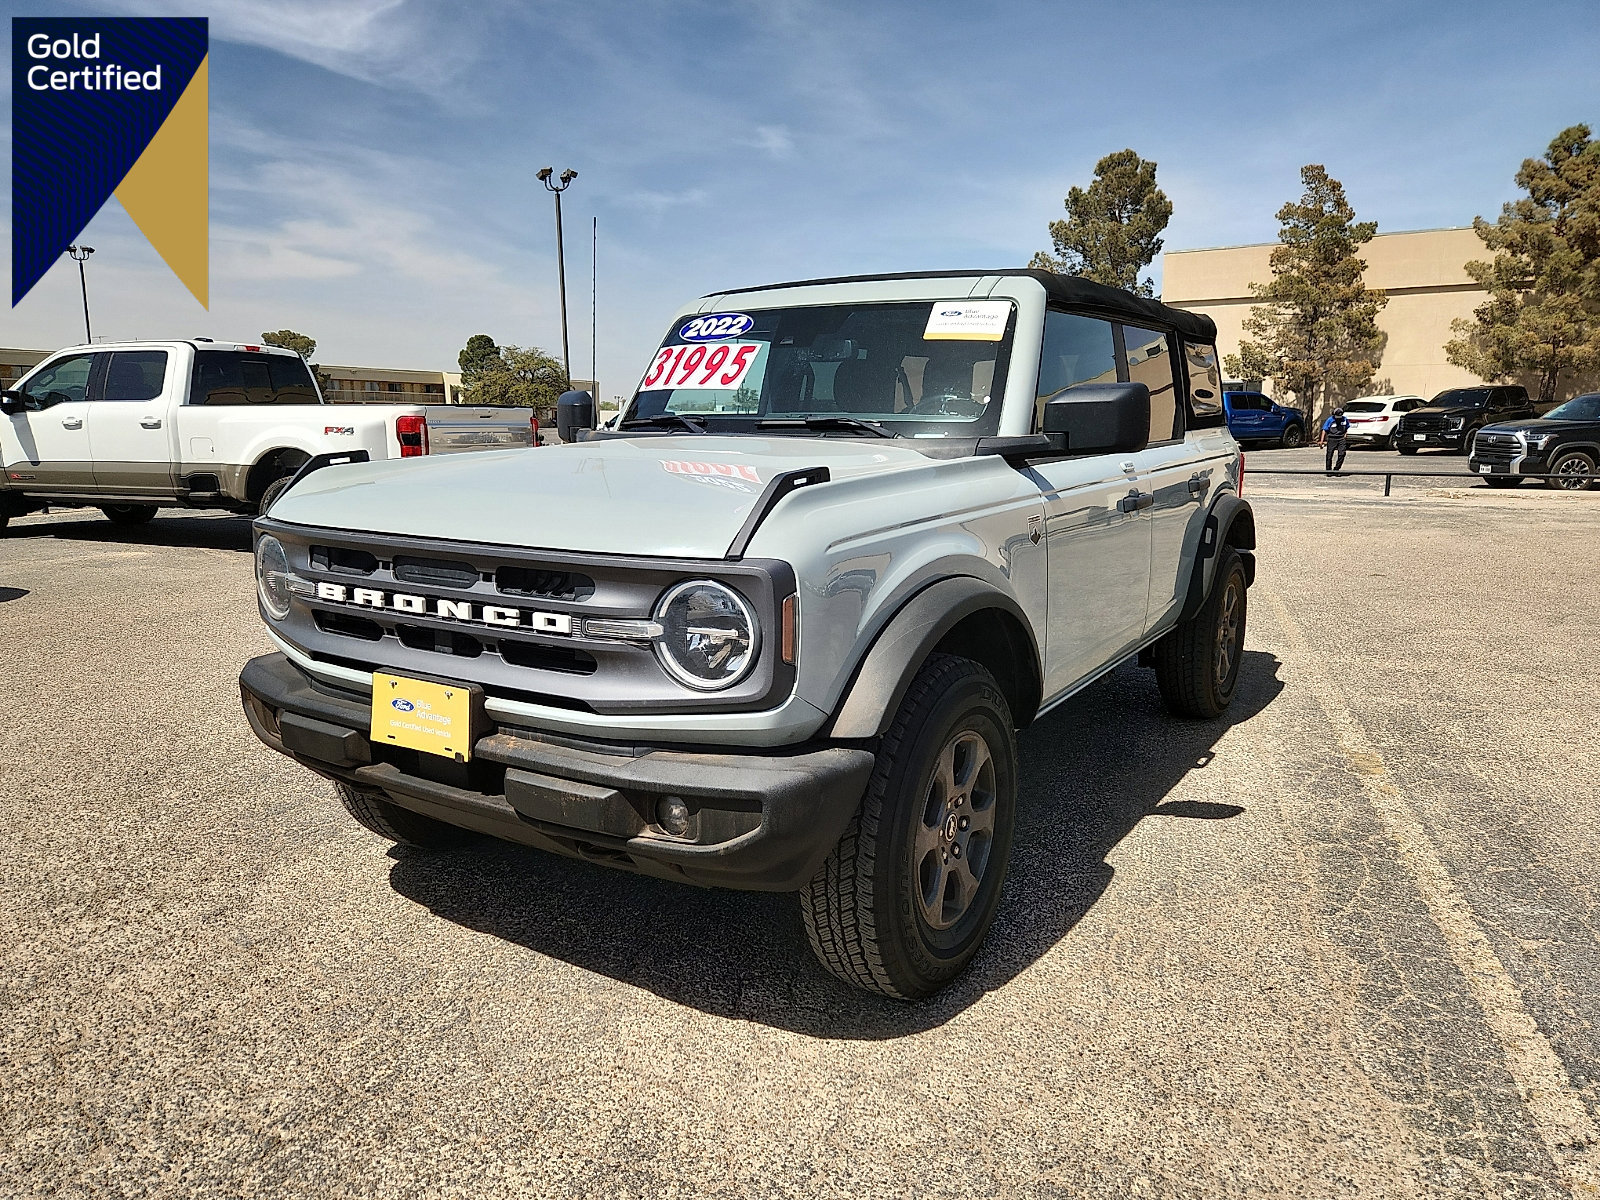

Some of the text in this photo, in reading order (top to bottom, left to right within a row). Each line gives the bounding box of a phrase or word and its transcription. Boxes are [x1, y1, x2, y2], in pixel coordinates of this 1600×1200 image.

[683, 316, 748, 338] 2022
[644, 345, 758, 388] 31995
[323, 426, 355, 436] FX4
[317, 581, 573, 634] BRONCO
[416, 700, 431, 710] Blue
[416, 710, 451, 725] Advantage
